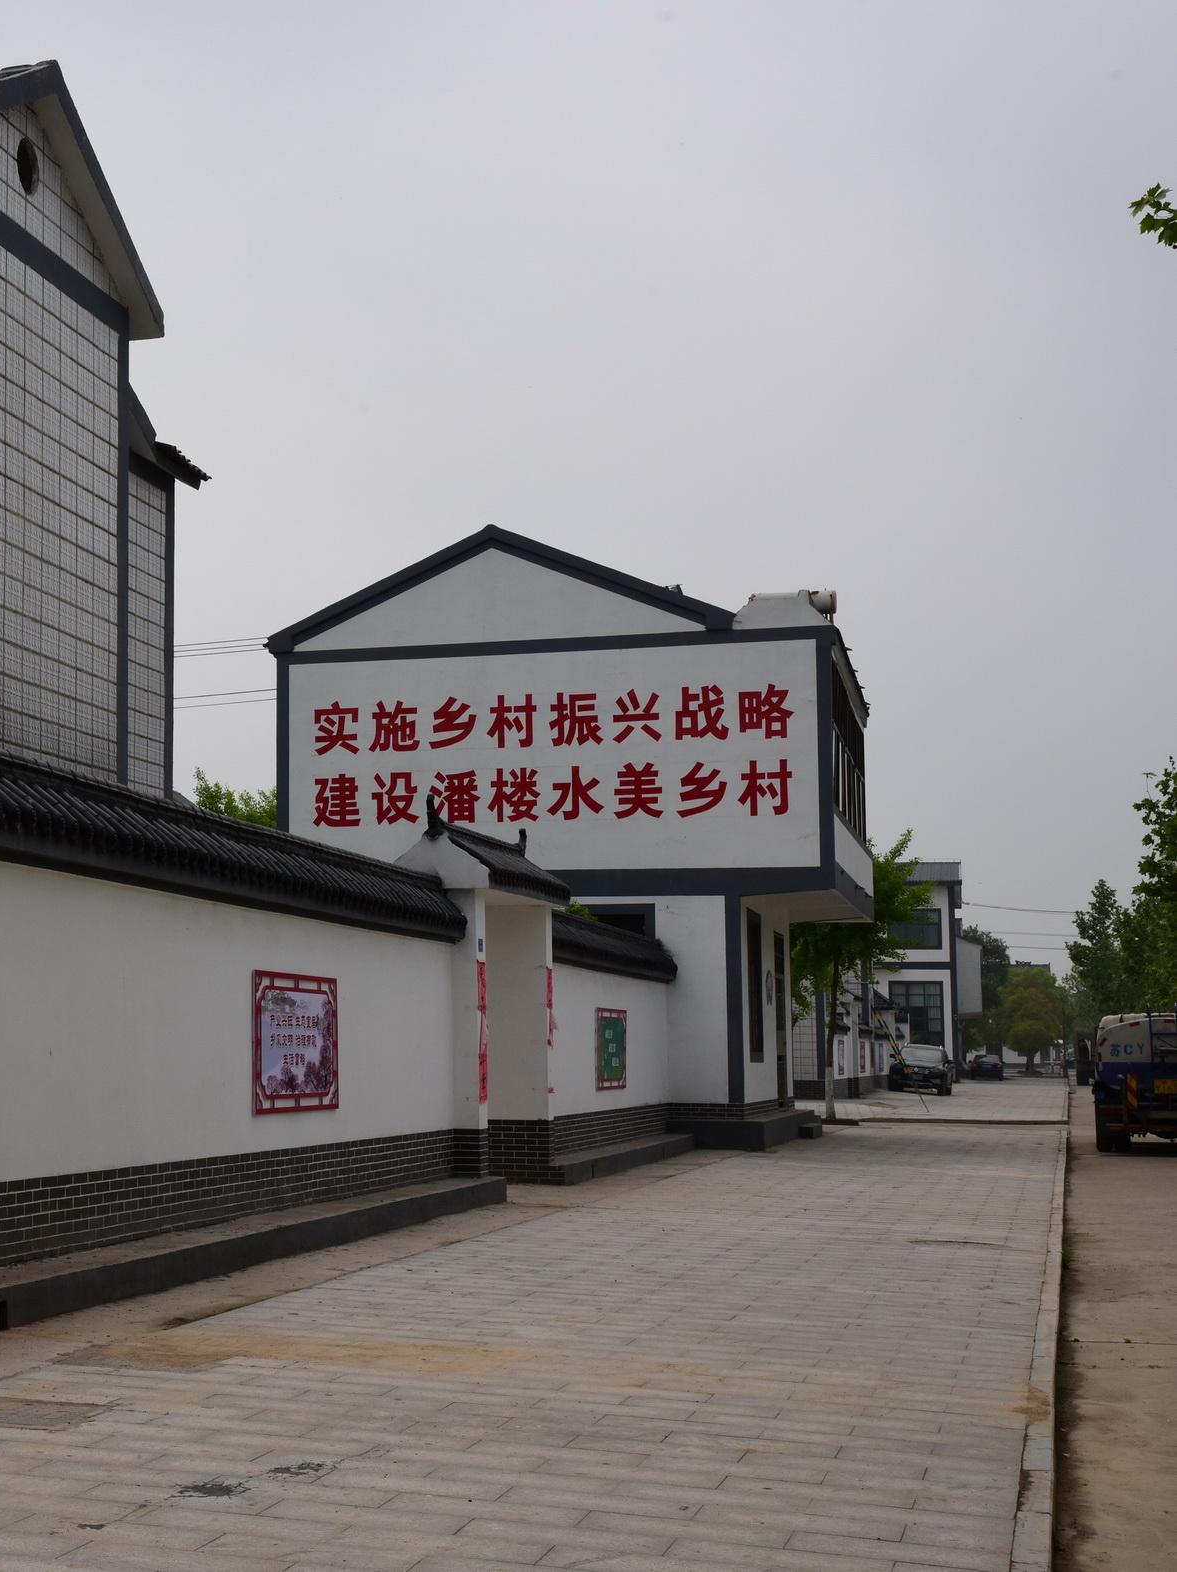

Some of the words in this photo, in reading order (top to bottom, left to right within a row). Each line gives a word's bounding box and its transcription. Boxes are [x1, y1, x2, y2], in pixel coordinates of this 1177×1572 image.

[315, 684, 794, 755] 实施乡村振兴战略
[314, 759, 793, 827] 建设潘楼水美乡村
